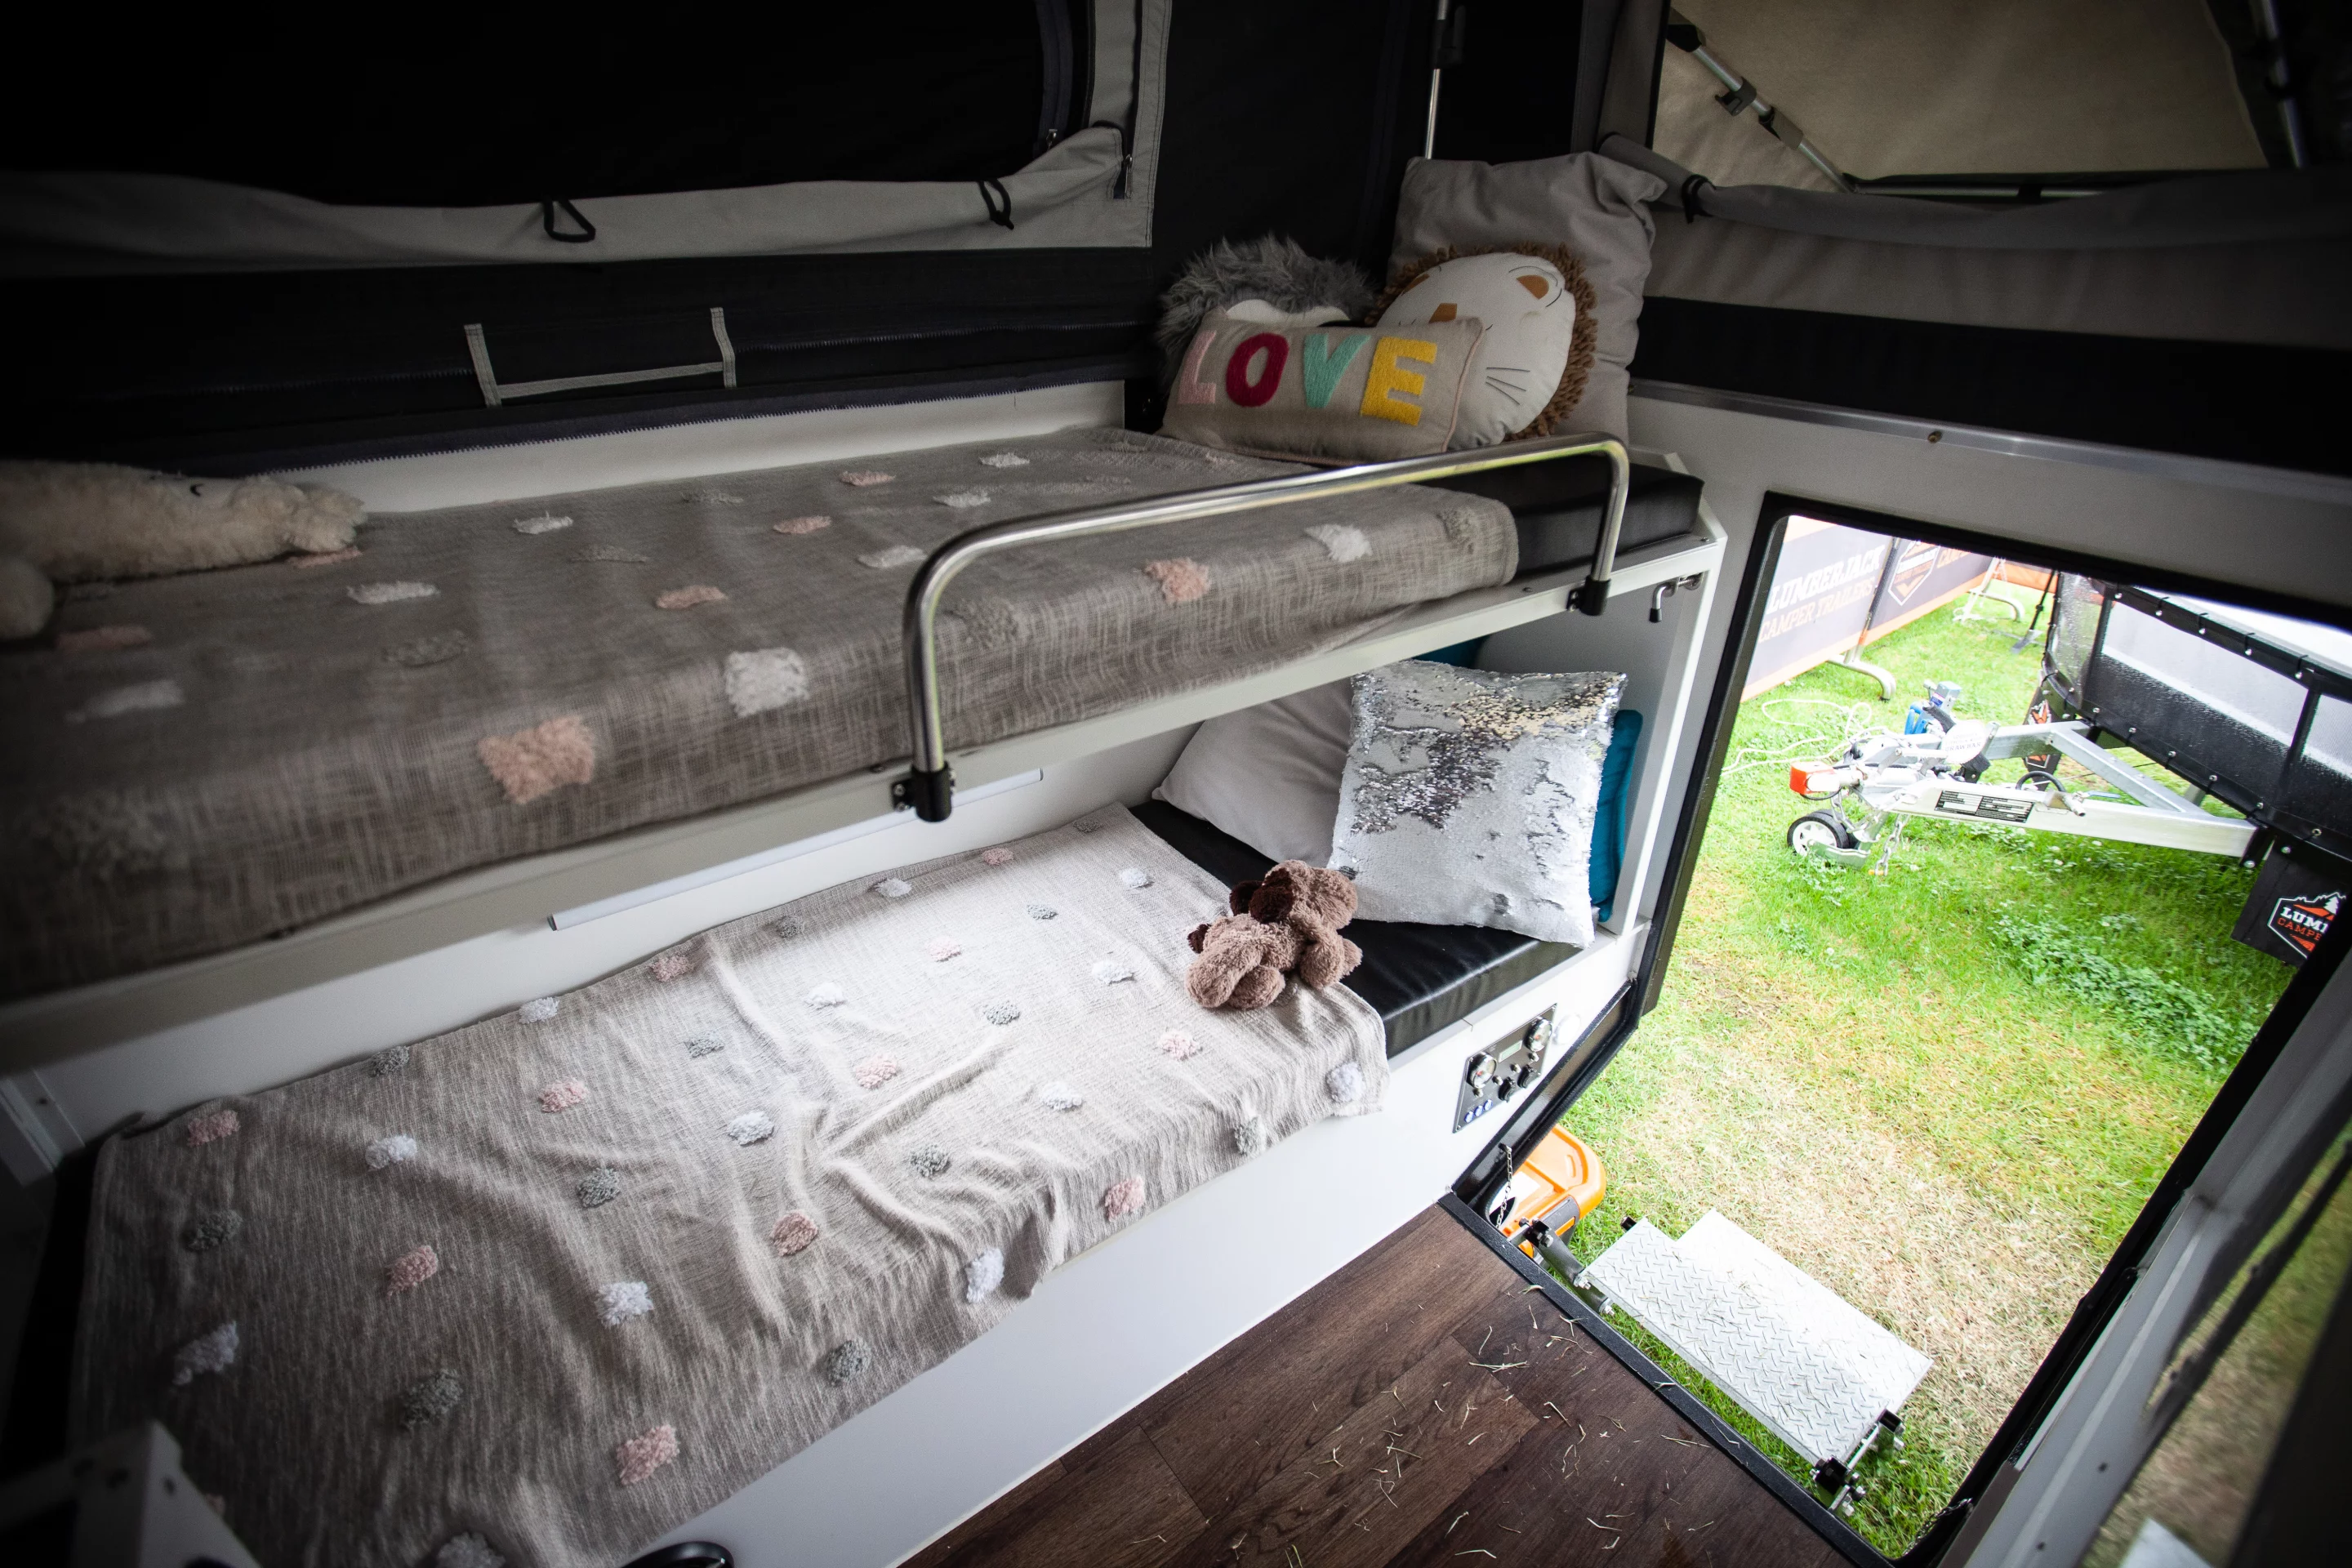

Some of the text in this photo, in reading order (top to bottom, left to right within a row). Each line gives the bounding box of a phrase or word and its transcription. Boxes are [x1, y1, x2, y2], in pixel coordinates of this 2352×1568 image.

[1177, 330, 1437, 426] LOVE
[1757, 576, 1875, 644] CAMPER TRAILERS
[1765, 544, 1886, 615] LUMBERJACK
